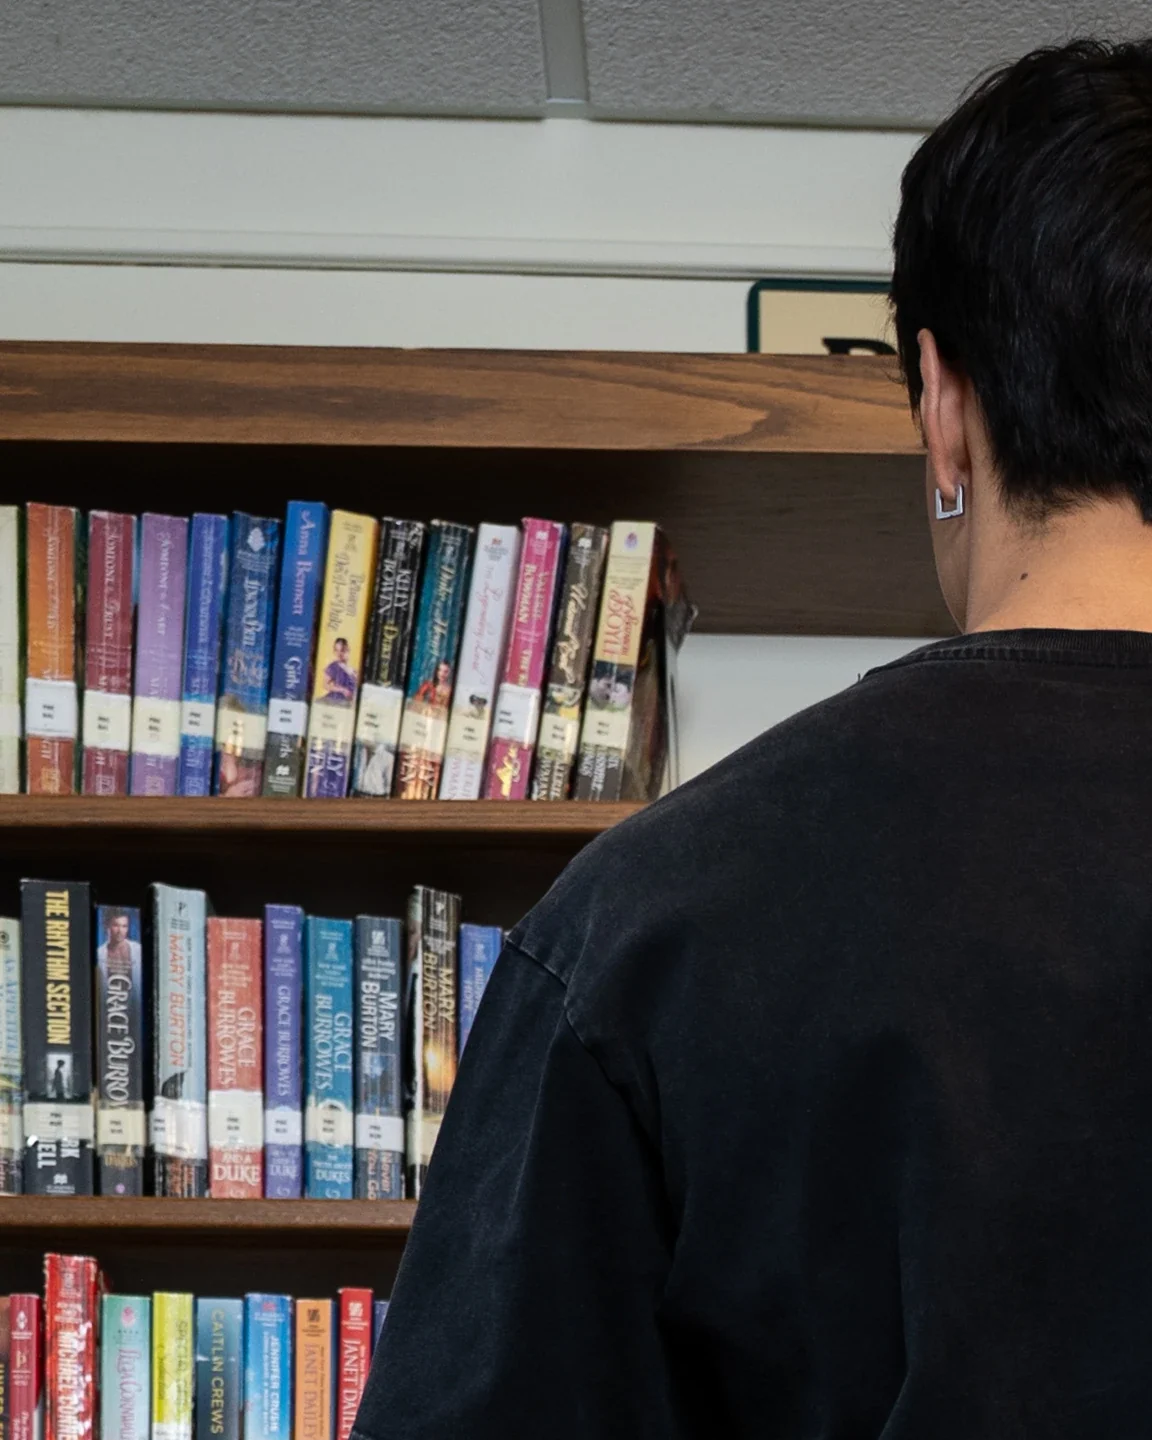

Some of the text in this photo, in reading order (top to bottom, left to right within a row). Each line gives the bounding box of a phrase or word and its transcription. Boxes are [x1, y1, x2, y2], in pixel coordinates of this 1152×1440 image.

[297, 511, 315, 555] Anna
[292, 560, 311, 616] Bennett
[378, 558, 396, 614] BOWEN
[395, 568, 412, 612] KELLY
[45, 890, 71, 1044] THE RHYTHM SECTION
[423, 952, 438, 1029] BURTON
[439, 968, 454, 1023] MARY
[169, 933, 186, 1067] MARY BURTON
[361, 981, 380, 1048] BURTON
[380, 991, 397, 1041] MARY
[217, 990, 238, 1085] BURROWES
[238, 1007, 256, 1067] GRACE
[277, 985, 290, 1096] GRACE BURROWES
[314, 994, 334, 1090] BURROWES
[334, 1012, 350, 1072] GRACE
[214, 1164, 261, 1184] DUKE
[56, 1331, 76, 1389] MICHAEL
[211, 1309, 224, 1434] CAITLIN CREWS
[270, 1335, 279, 1389] JENNIFER
[343, 1339, 360, 1384] JANET
[303, 1343, 318, 1440] JANET DAILEY
